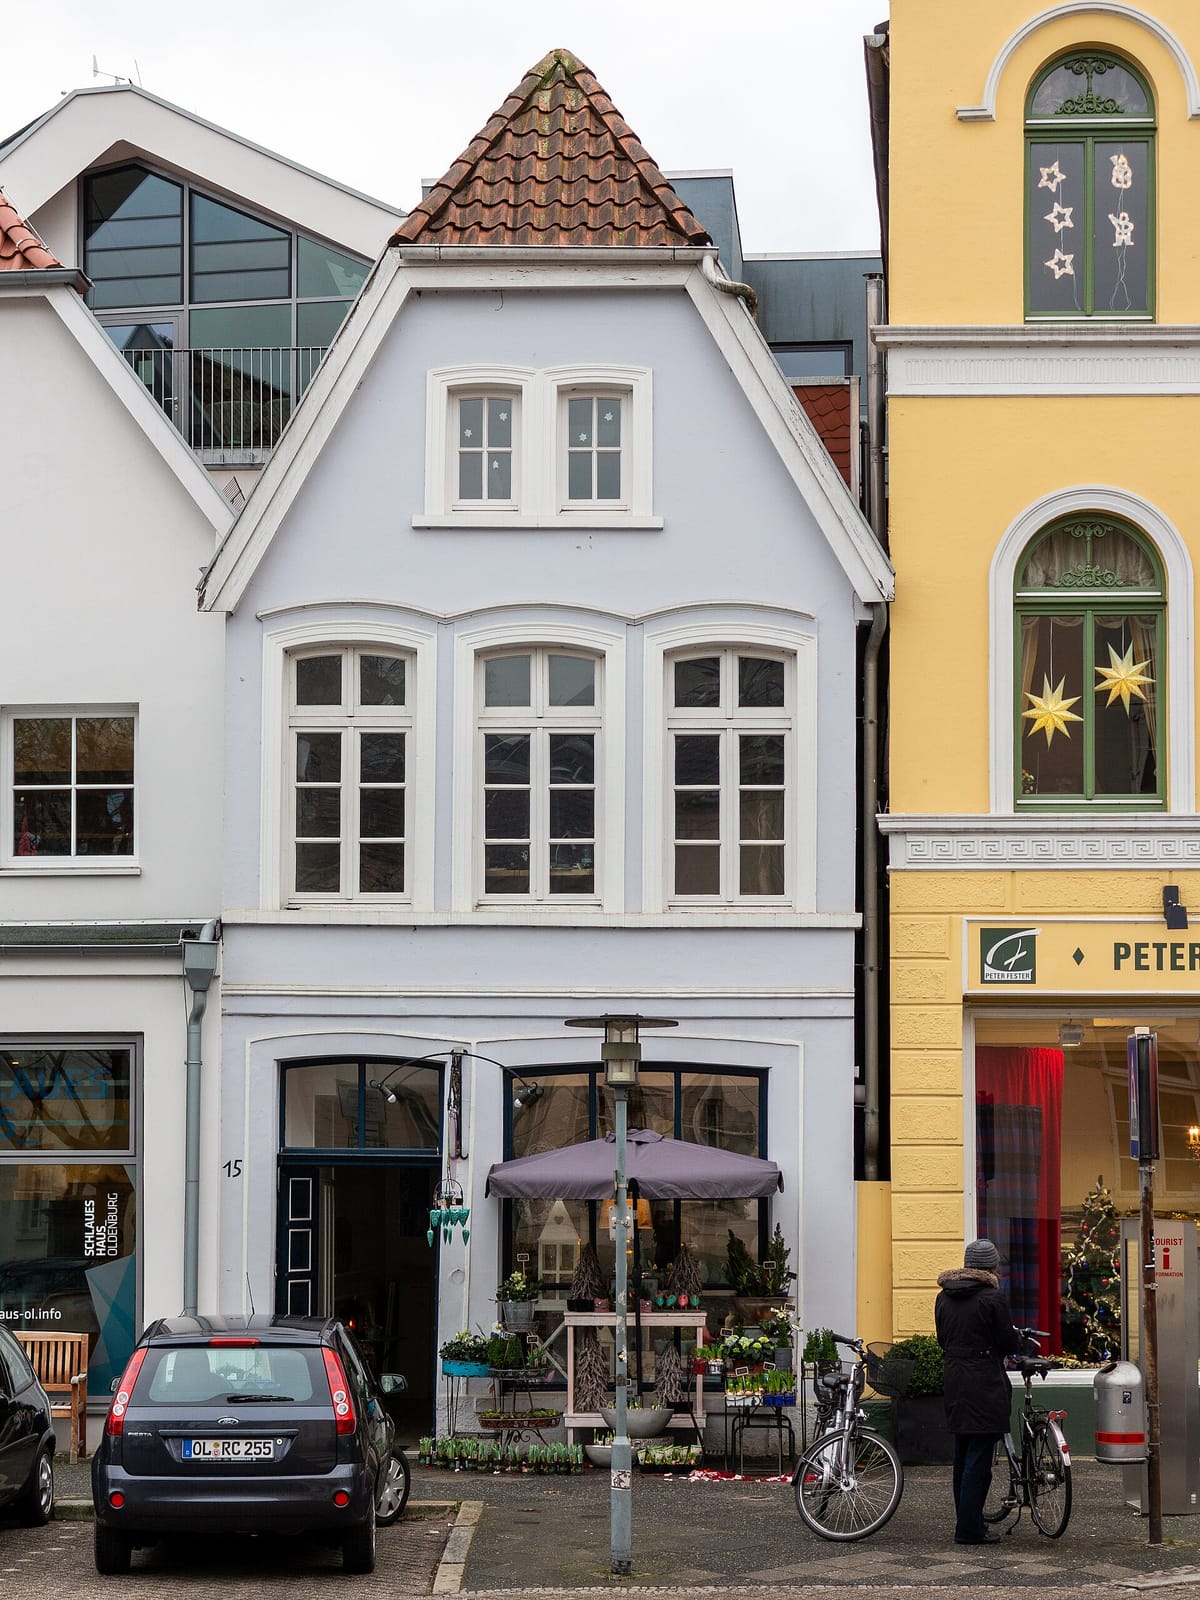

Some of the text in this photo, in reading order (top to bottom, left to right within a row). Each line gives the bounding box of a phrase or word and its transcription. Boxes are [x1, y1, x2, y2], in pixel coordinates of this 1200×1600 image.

[1114, 943, 1200, 970] PETER
[222, 1160, 242, 1177] 15
[85, 1200, 95, 1256] SCHLAUES
[107, 1193, 118, 1256] OLDENBURG
[1155, 1238, 1182, 1246] OURIST
[193, 1442, 272, 1456] OL RC 255
